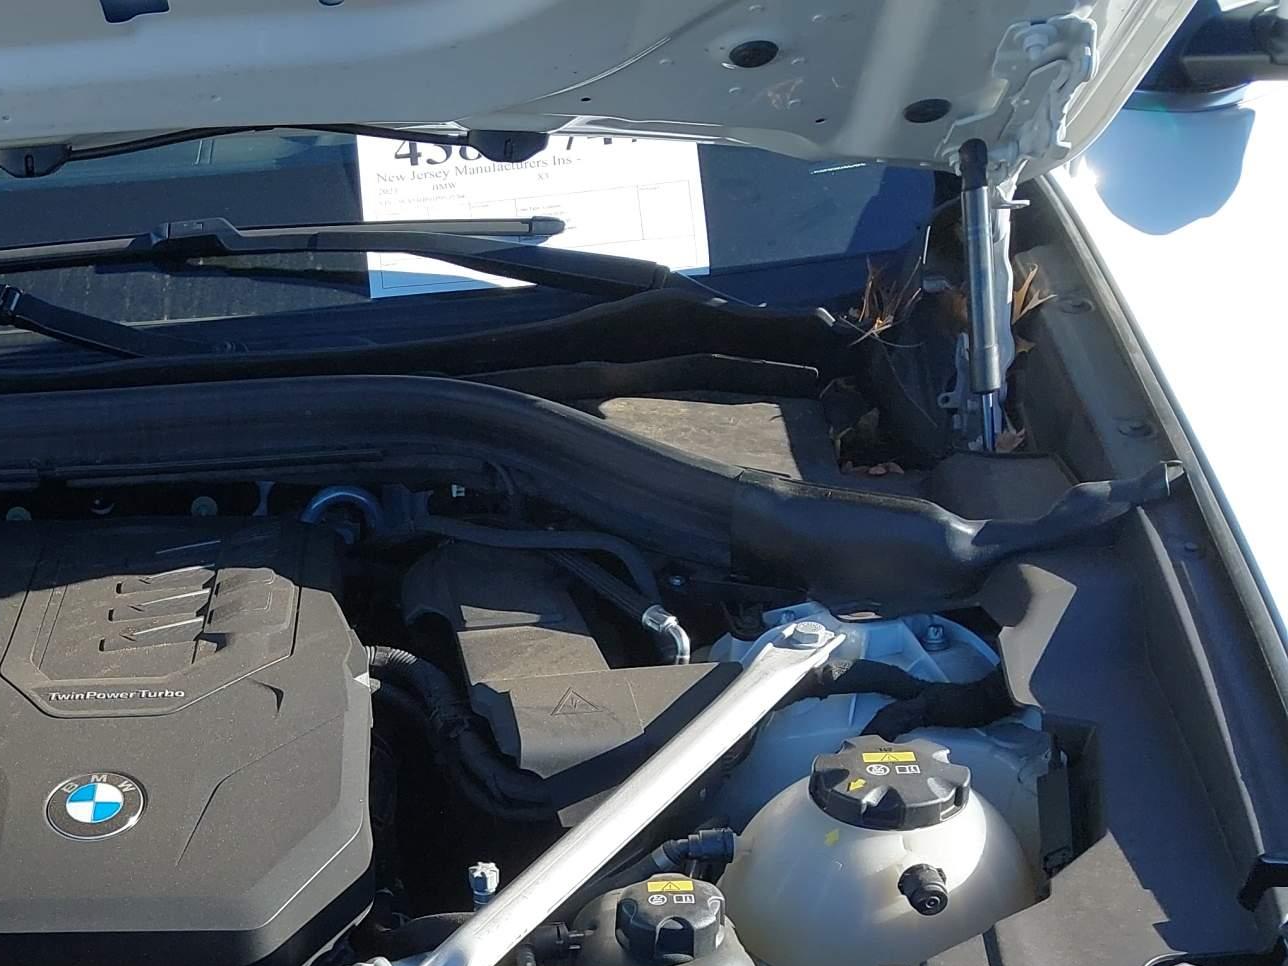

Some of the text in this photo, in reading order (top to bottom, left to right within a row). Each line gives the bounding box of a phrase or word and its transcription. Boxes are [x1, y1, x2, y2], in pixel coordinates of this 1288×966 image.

[376, 172, 406, 184] New
[410, 169, 450, 181] Jersey
[455, 157, 549, 177] Manufacturers
[553, 155, 573, 167] Ins
[432, 182, 457, 191] BMW
[61, 773, 137, 794] BMW
